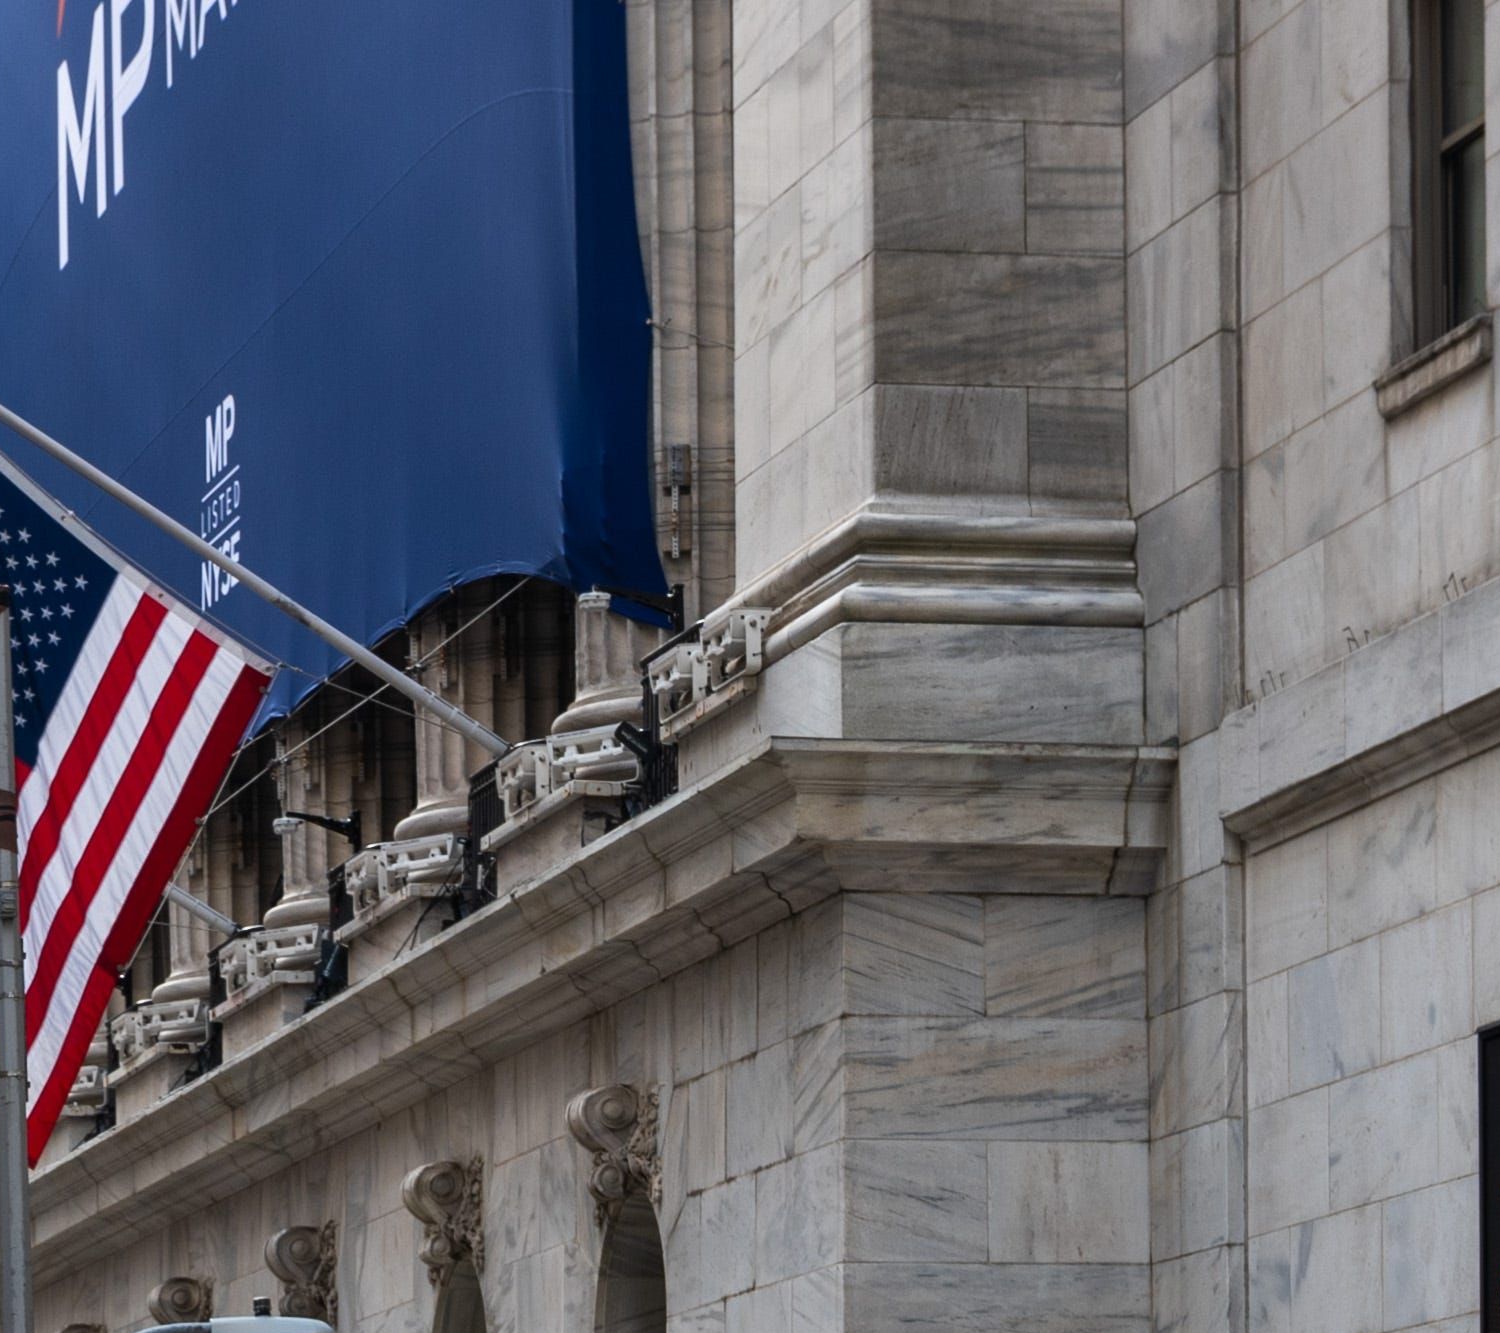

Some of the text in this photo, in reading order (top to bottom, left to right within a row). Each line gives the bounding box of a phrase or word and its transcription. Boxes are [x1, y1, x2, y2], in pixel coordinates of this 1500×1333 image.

[56, 0, 155, 271] MP
[205, 393, 236, 484] MP
[200, 479, 241, 539] LISTED
